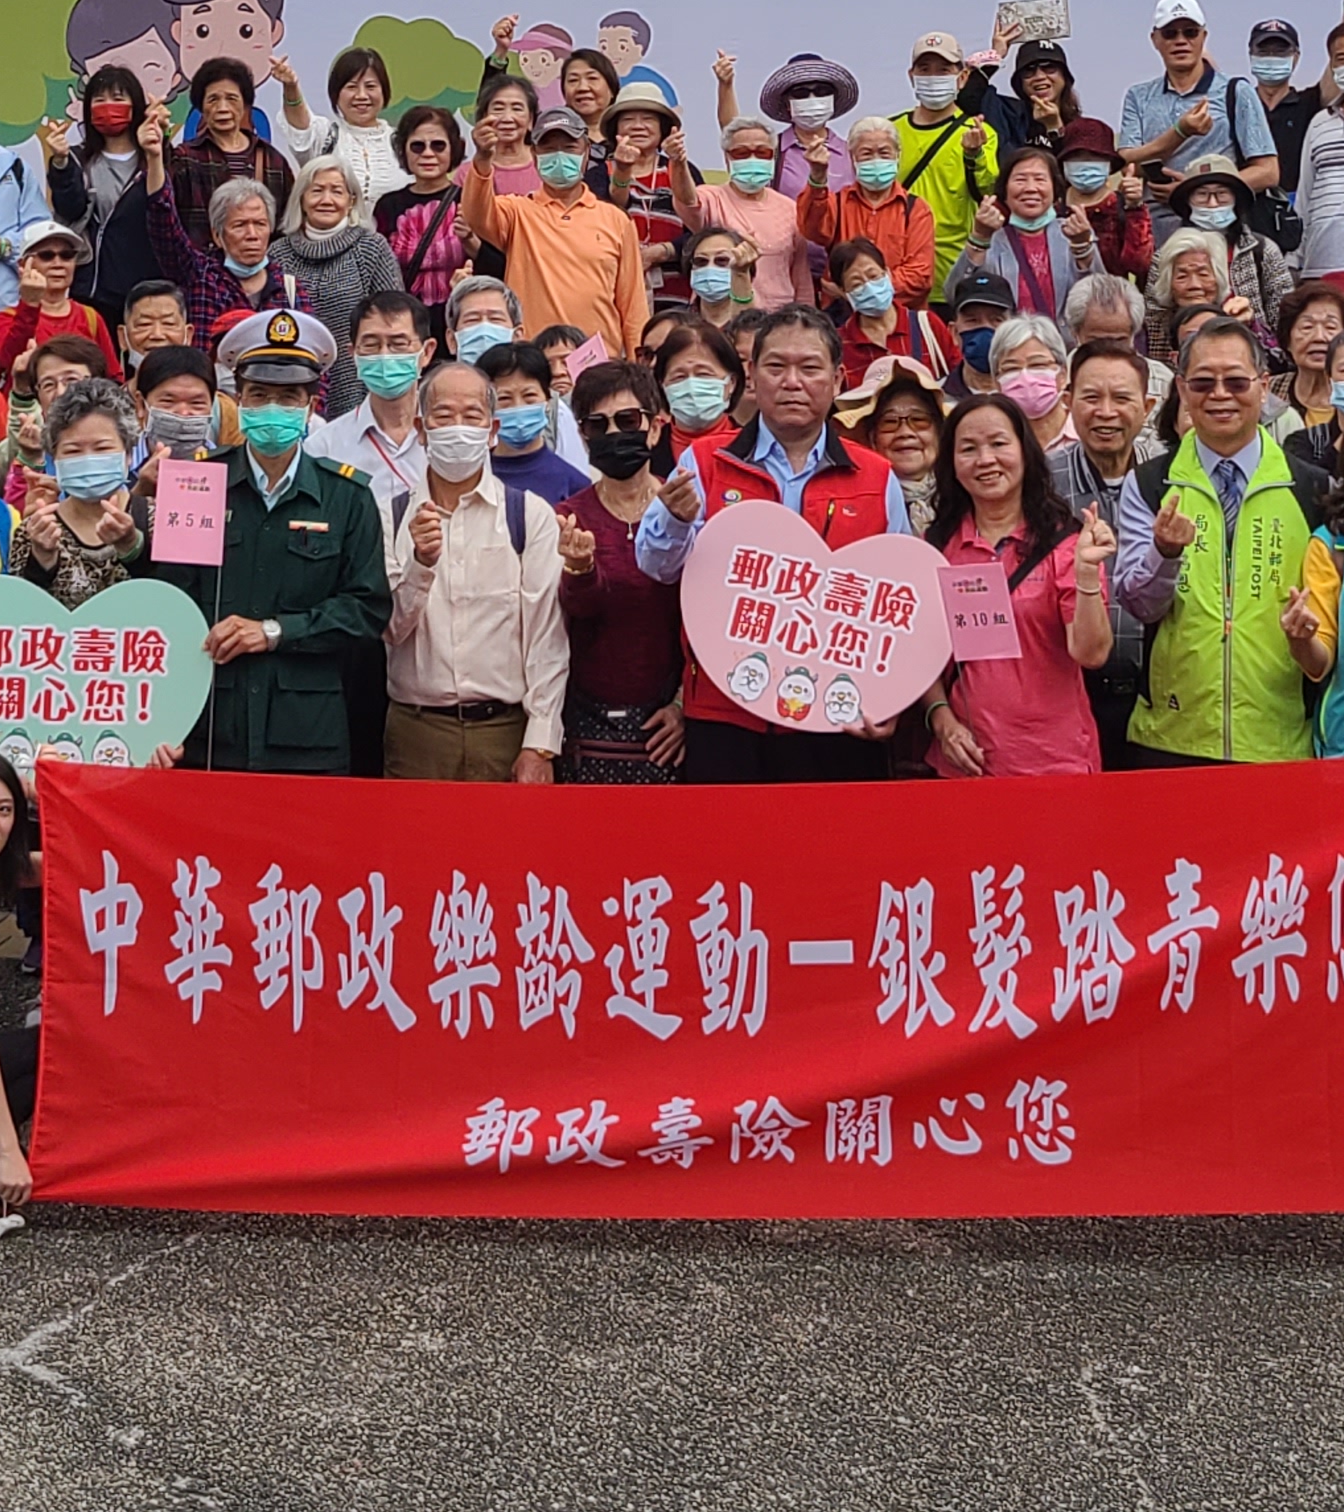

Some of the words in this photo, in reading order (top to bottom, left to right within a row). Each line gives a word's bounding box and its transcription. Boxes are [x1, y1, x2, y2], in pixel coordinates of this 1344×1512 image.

[1251, 516, 1263, 560] TAIPEI
[727, 547, 918, 631] 郵政壽險
[1250, 564, 1262, 600] POST
[729, 596, 894, 673] 關心您!
[461, 1075, 1076, 1173] 郵政壽險關心您
